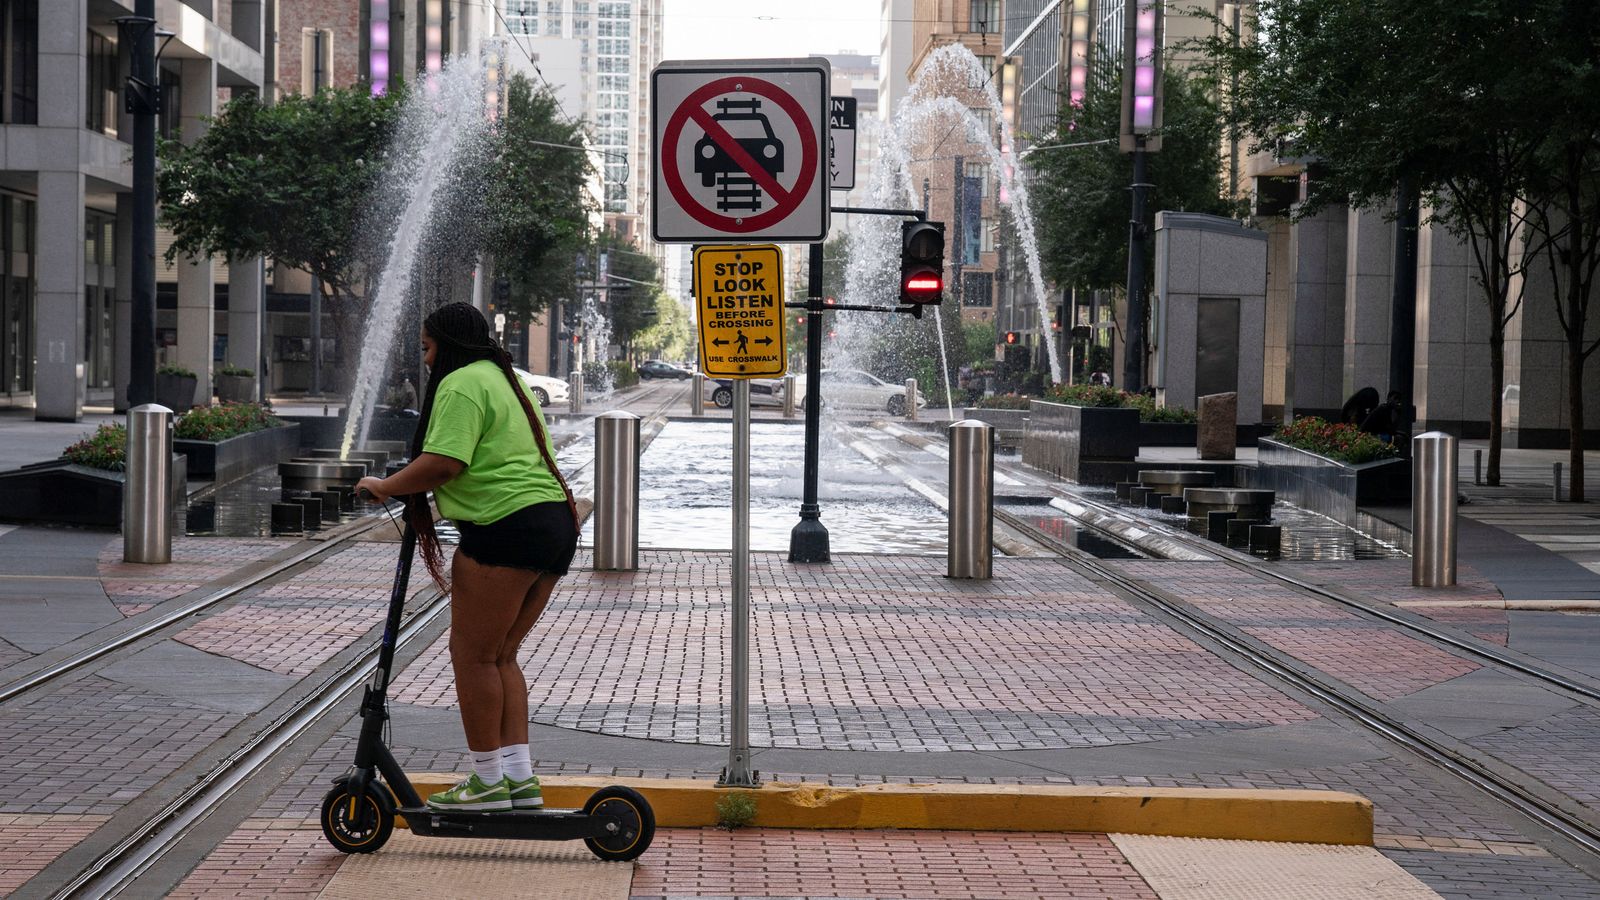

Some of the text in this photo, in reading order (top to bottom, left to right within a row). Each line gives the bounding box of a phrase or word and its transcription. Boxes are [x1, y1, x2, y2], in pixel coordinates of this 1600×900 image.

[714, 262, 763, 276] STOP
[714, 279, 766, 293] LOOK
[707, 295, 773, 309] LISTEN
[716, 311, 766, 319] BEFORE
[708, 320, 774, 328] CROSSING
[728, 355, 778, 363] CROSSWALK
